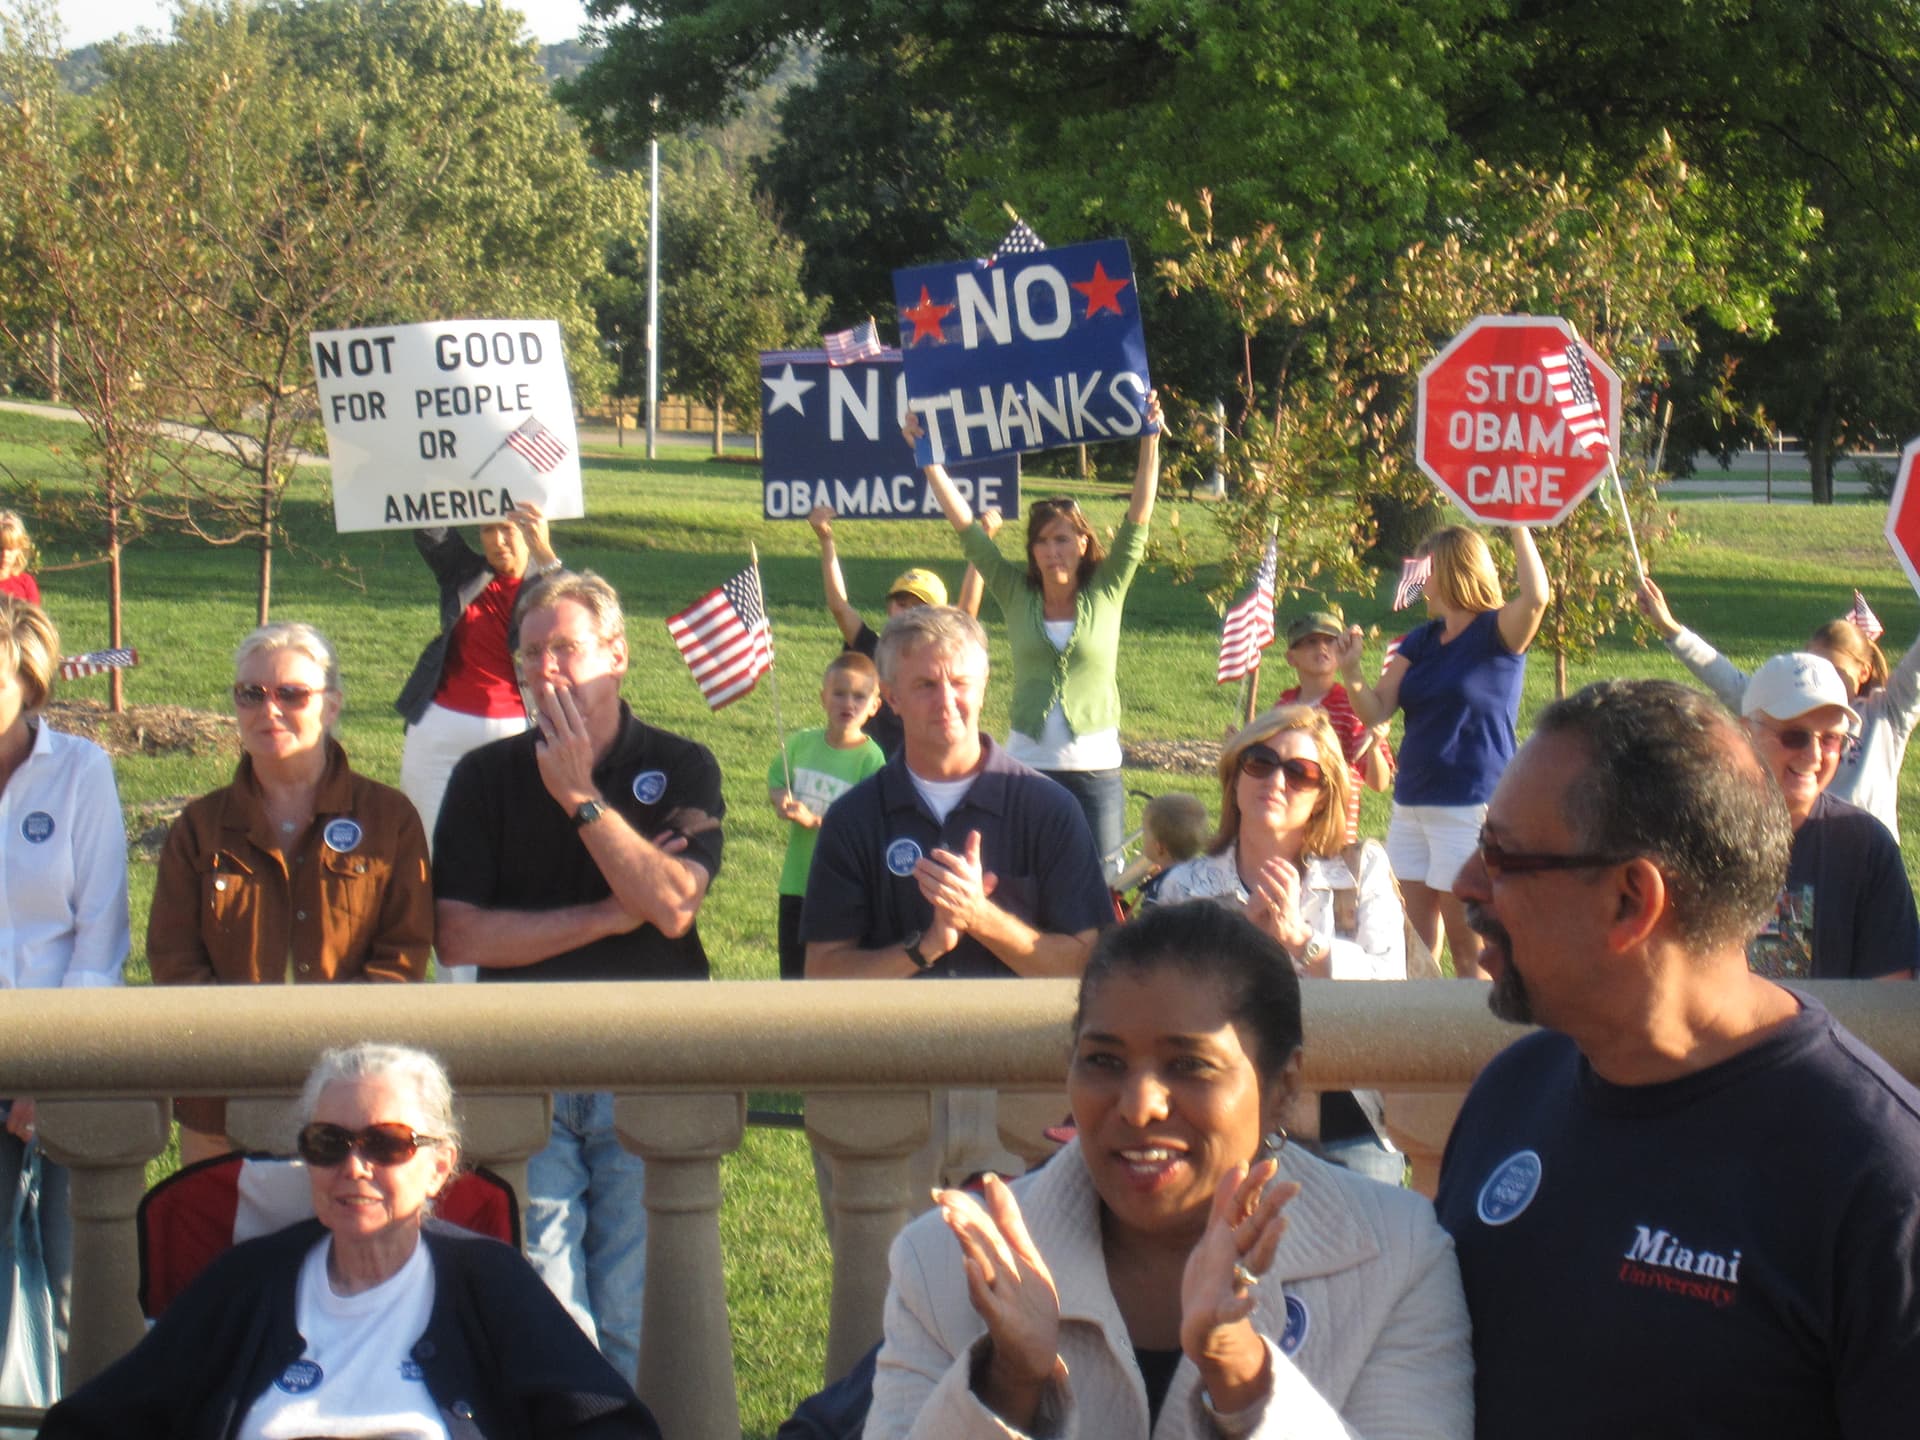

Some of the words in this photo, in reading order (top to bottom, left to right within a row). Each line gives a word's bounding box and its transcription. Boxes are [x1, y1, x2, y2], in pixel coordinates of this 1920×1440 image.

[956, 264, 1072, 350] NO
[315, 336, 395, 379] NOT
[435, 332, 543, 372] GOOD
[331, 391, 387, 424] FOR
[415, 383, 532, 419] PEOPLE
[829, 368, 907, 441] N
[908, 370, 1144, 465] THANKS
[419, 429, 457, 460] OR
[384, 487, 517, 523] AMERICA
[1466, 465, 1565, 507] CARE
[1623, 1224, 1743, 1284] Miami
[1619, 1263, 1736, 1306] University
